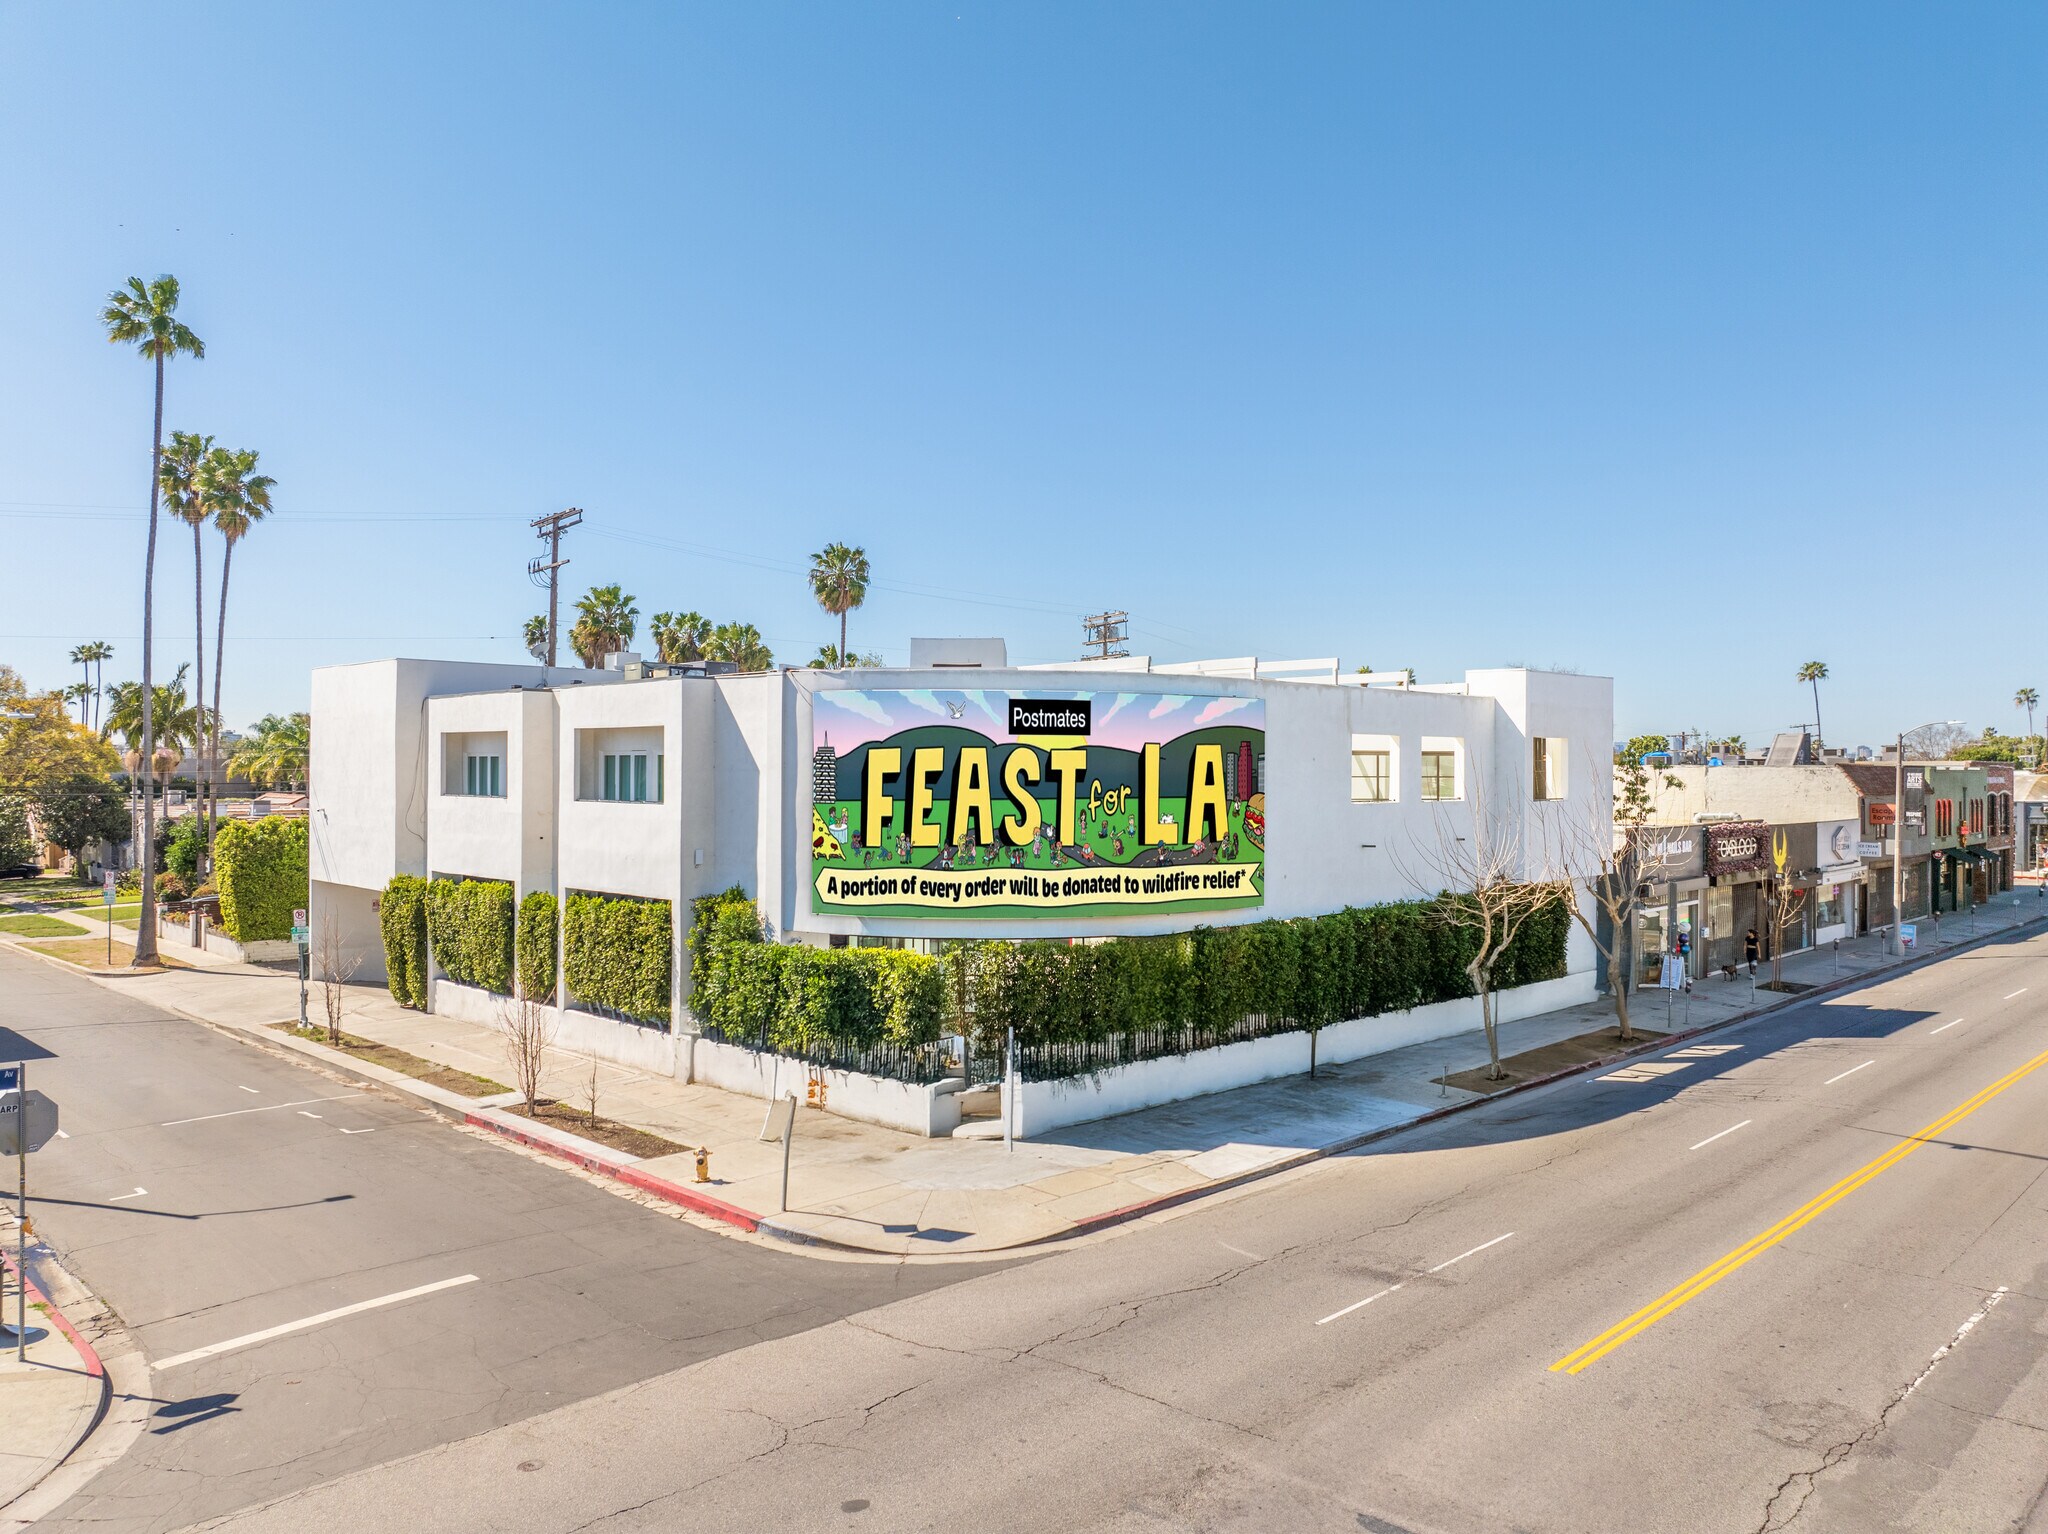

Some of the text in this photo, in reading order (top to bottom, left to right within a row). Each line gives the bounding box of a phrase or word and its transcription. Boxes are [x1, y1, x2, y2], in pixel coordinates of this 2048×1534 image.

[1012, 706, 1087, 728] Postmates
[862, 742, 1230, 848] FEAST for LA
[1871, 807, 1895, 815] Escap
[827, 876, 838, 894] A
[841, 876, 898, 899] portion
[901, 876, 917, 895] of
[920, 879, 962, 902] every
[965, 876, 1007, 898] order
[1010, 876, 1039, 897] will
[1042, 877, 1060, 898] be
[1063, 874, 1122, 896] donated
[1124, 875, 1140, 894] to
[1142, 871, 1200, 894] wildfire
